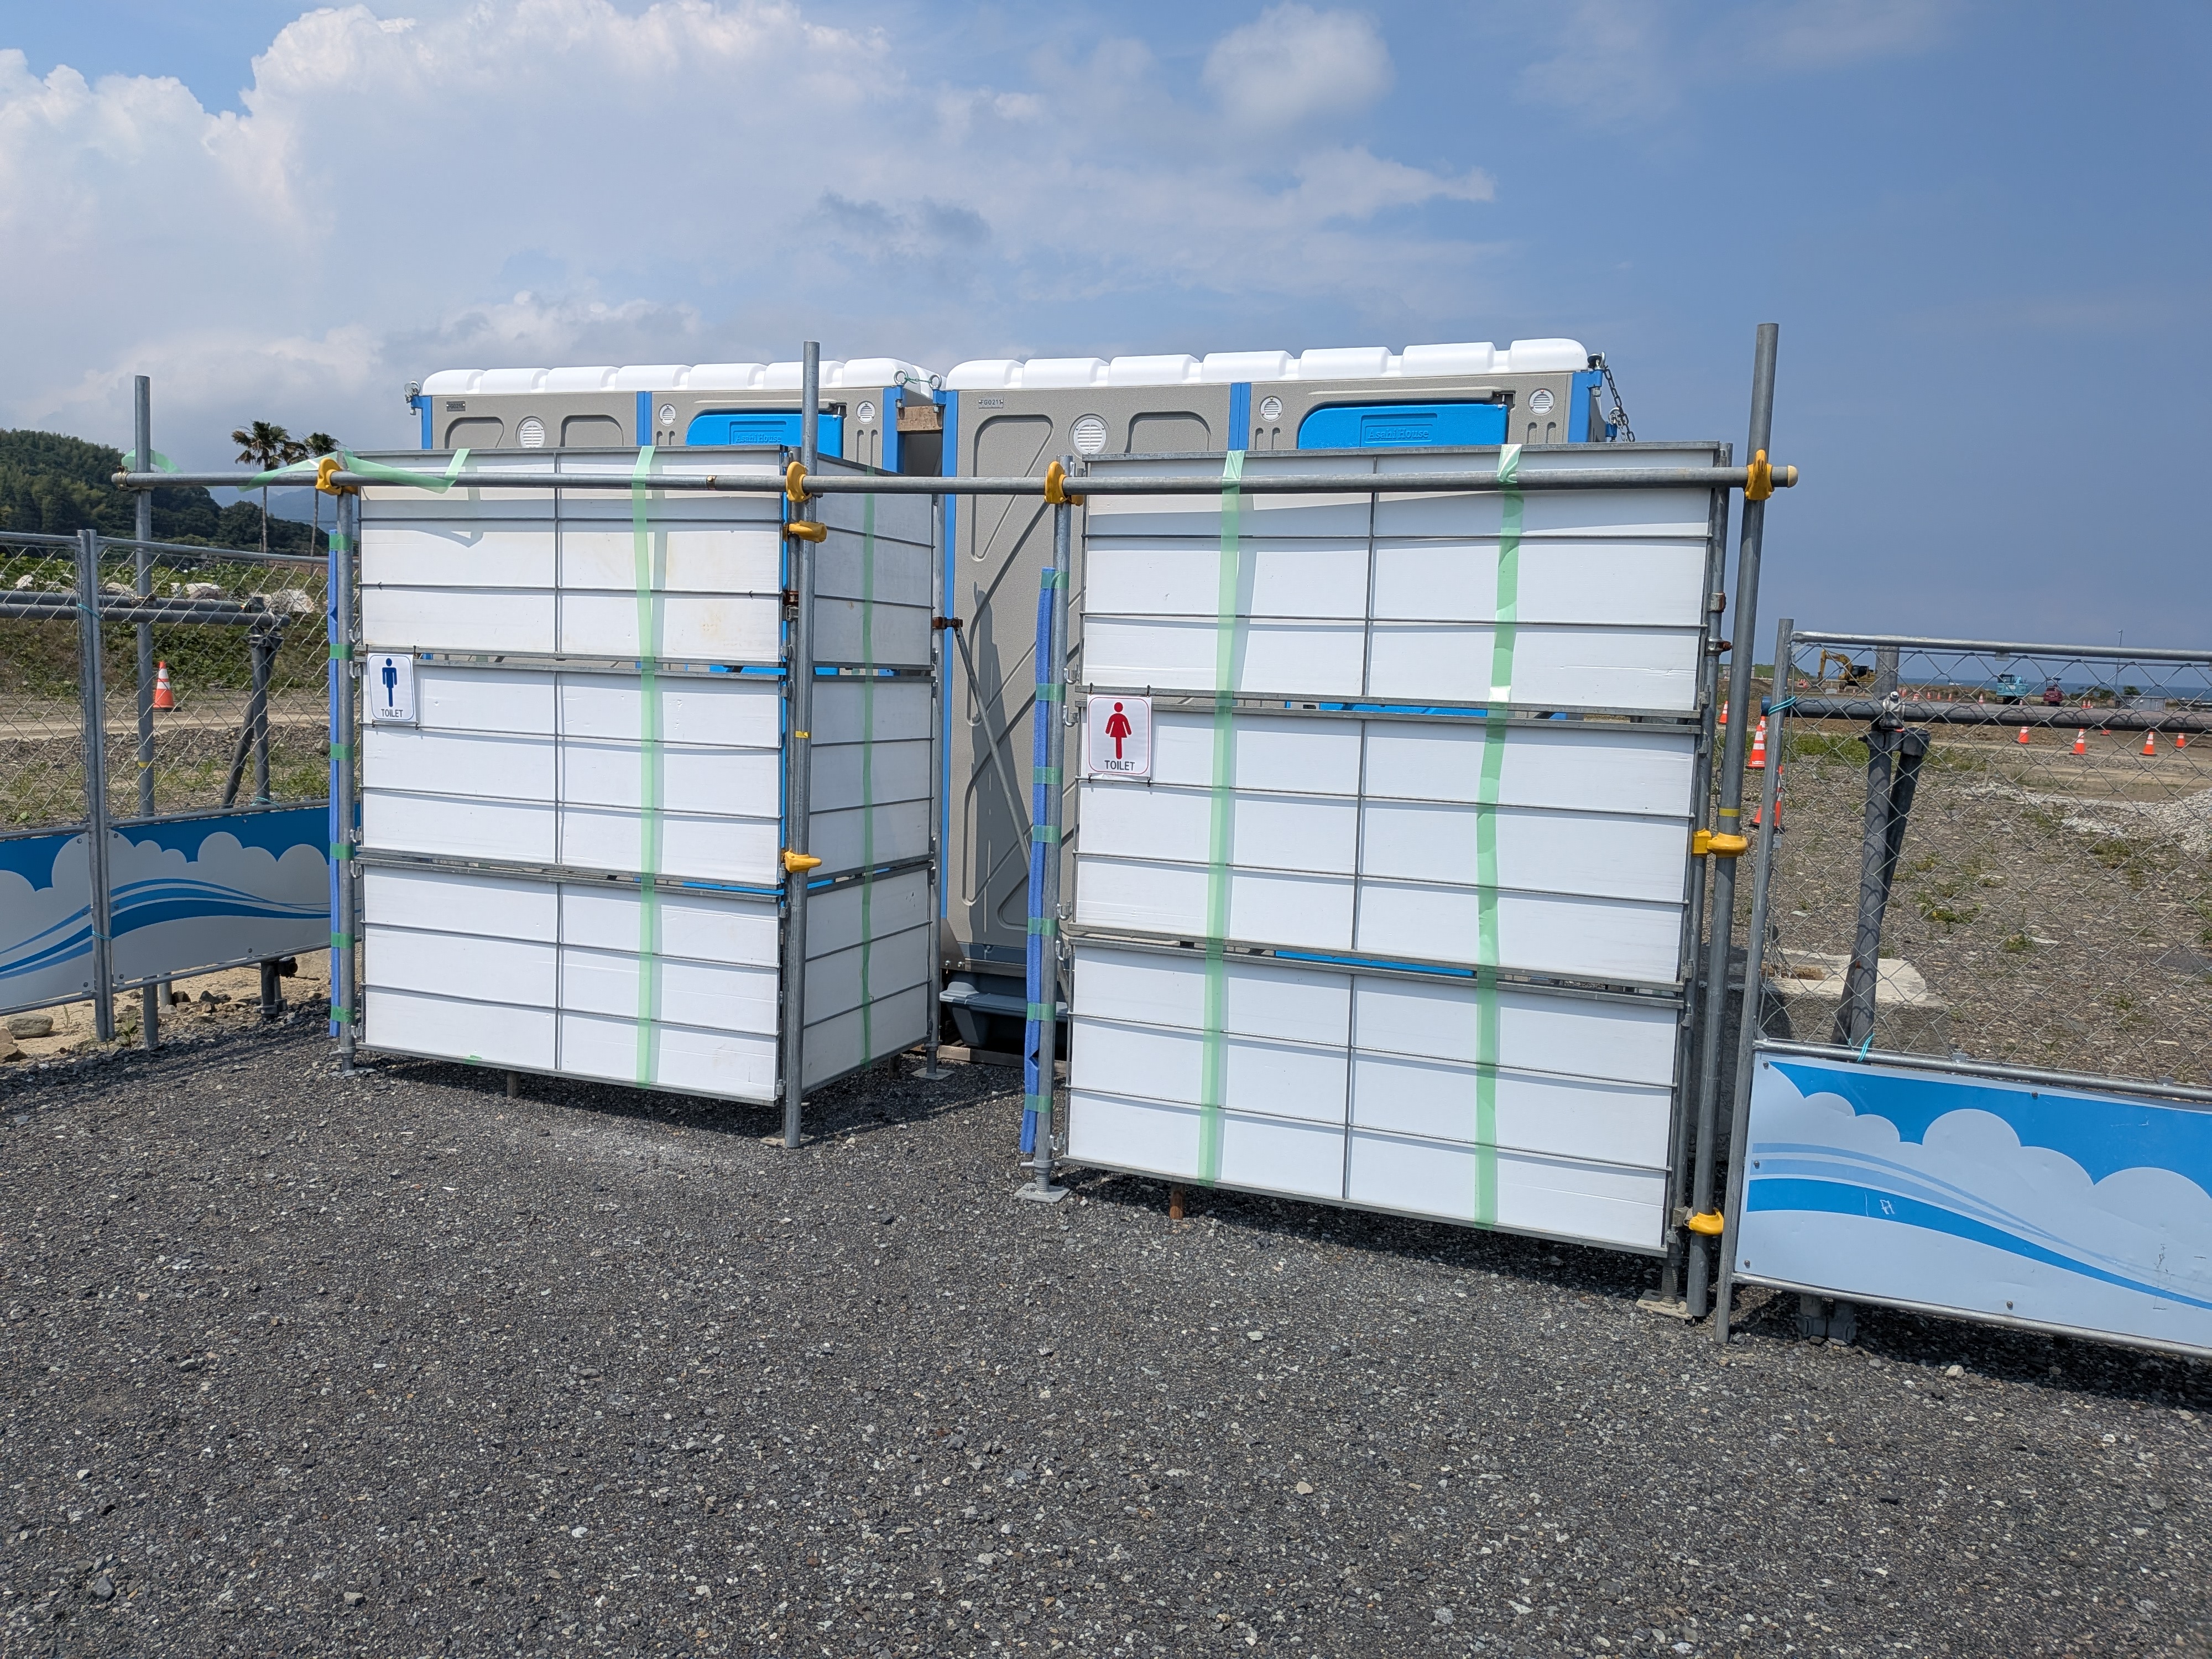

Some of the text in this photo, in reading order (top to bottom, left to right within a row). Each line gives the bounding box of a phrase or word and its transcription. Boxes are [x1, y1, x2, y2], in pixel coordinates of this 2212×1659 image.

[736, 434, 781, 443] Asahi House
[1368, 428, 1429, 440] Asahi House
[380, 708, 403, 717] TOILET
[1104, 760, 1135, 771] TOILET
